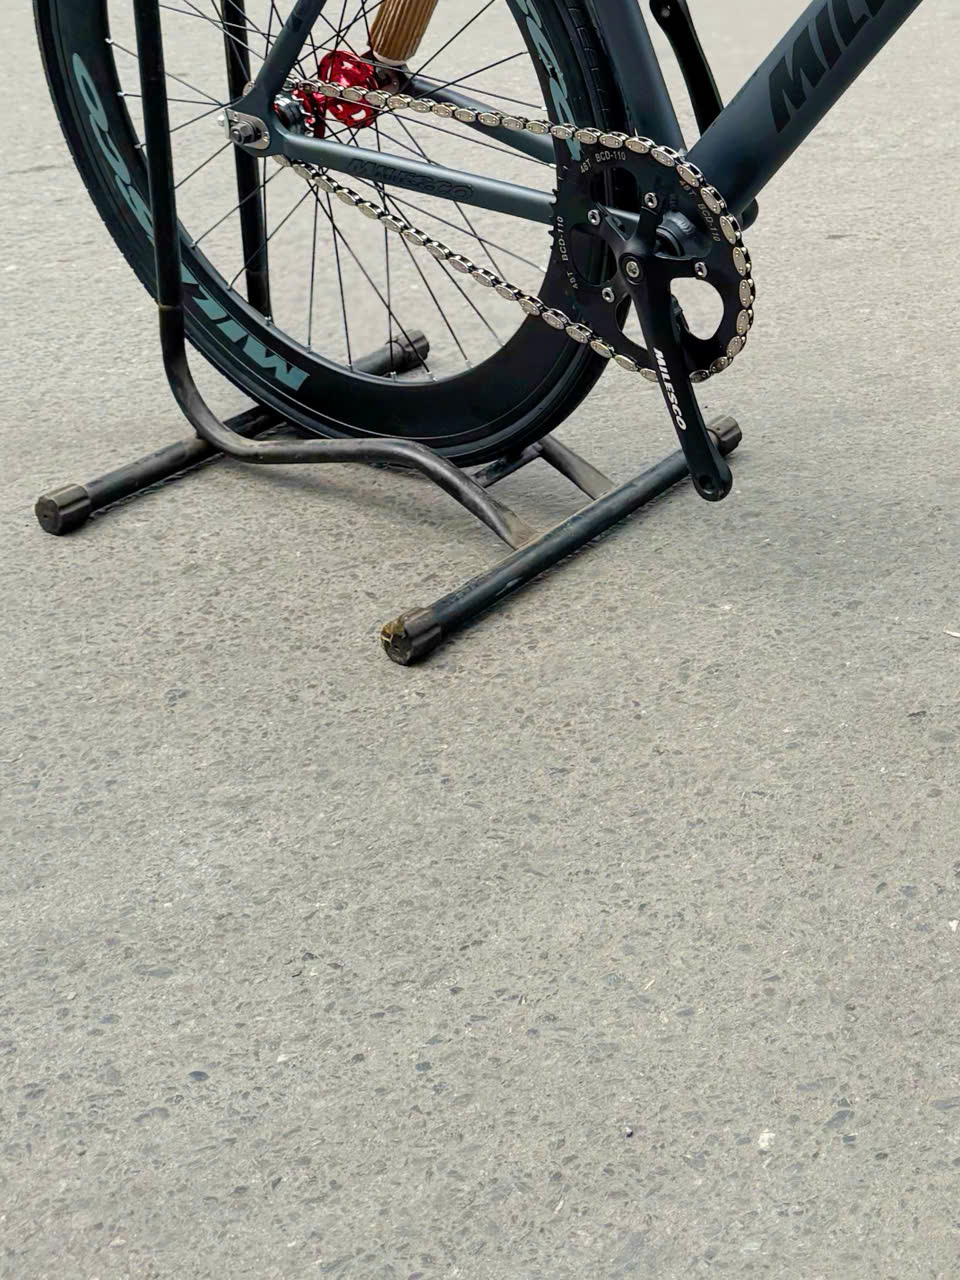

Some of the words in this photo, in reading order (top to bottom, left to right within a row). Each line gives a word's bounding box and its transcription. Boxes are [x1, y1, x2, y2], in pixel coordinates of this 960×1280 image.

[594, 150, 627, 163] BCD-110
[72, 53, 311, 392] MILSCO
[556, 215, 569, 262] BCD-110
[653, 346, 687, 431] MILESCO
